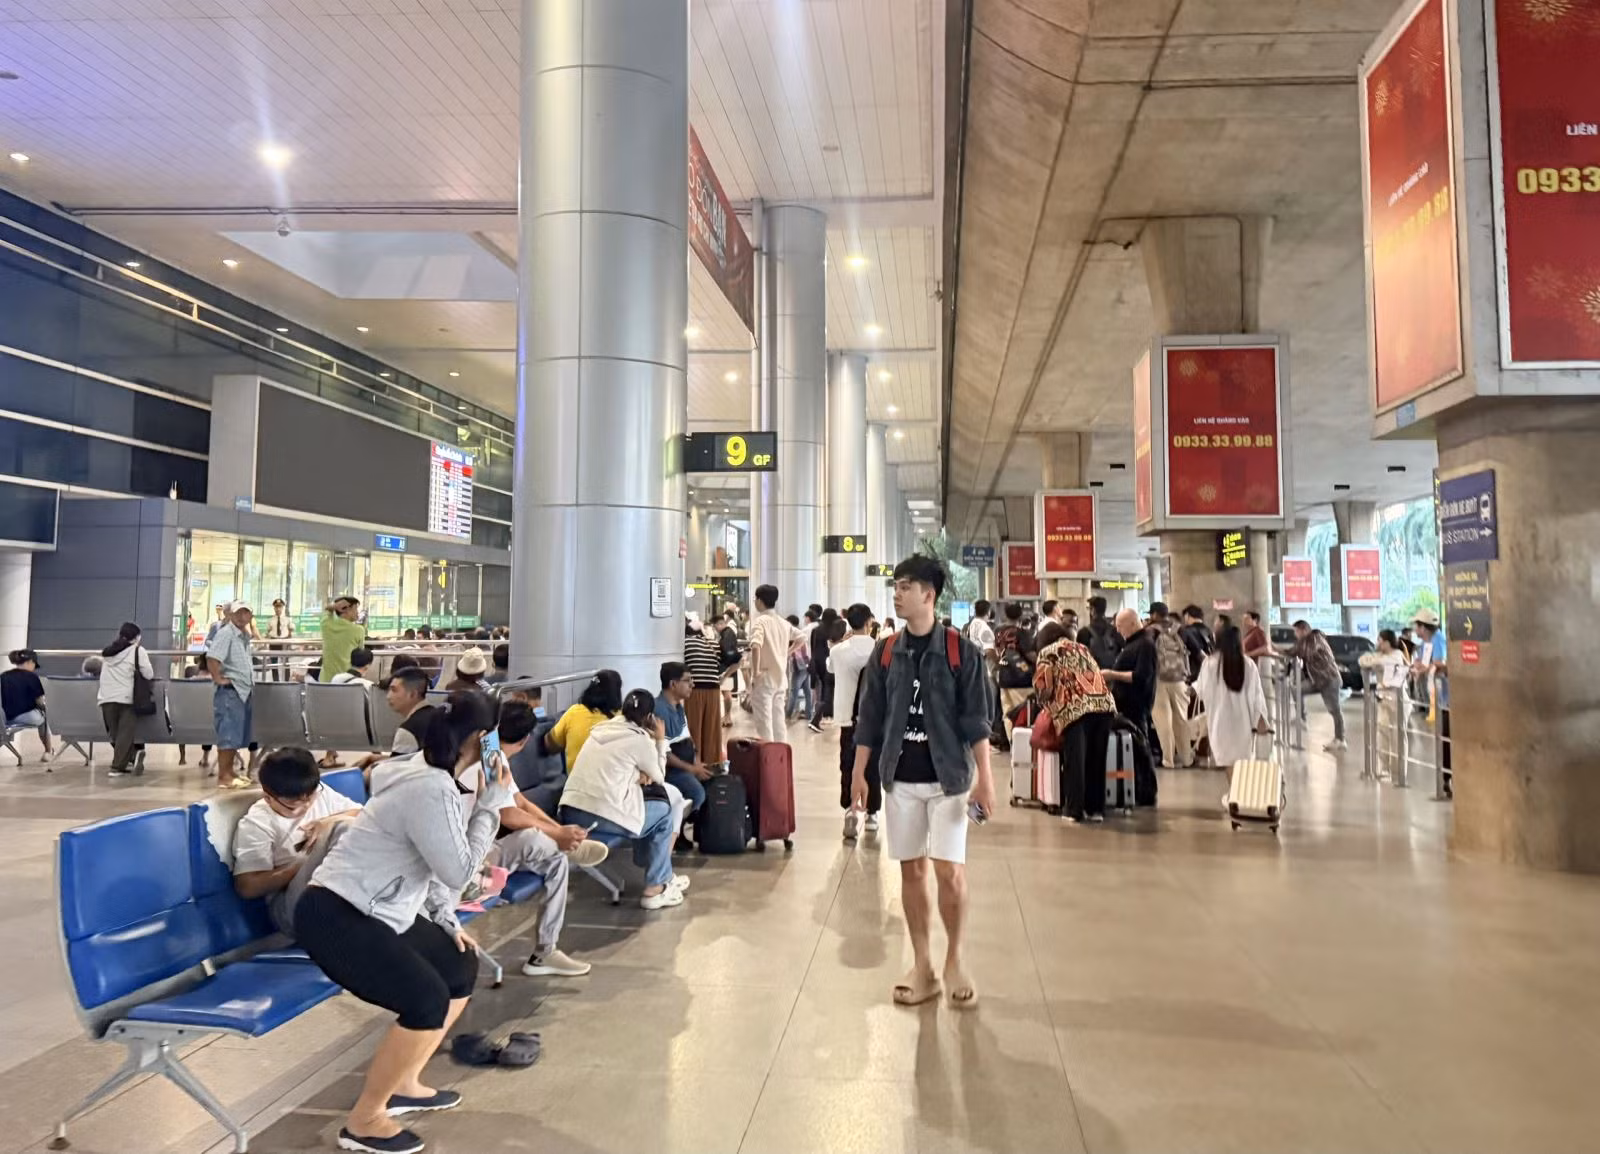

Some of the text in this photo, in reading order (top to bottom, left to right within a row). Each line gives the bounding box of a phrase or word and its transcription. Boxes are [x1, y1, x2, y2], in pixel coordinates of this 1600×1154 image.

[1566, 121, 1598, 136] LIÊN
[1517, 167, 1600, 194] 0933
[1173, 434, 1273, 448] 0933.33.99.88
[726, 435, 771, 466] 9 GF
[843, 536, 854, 552] 8
